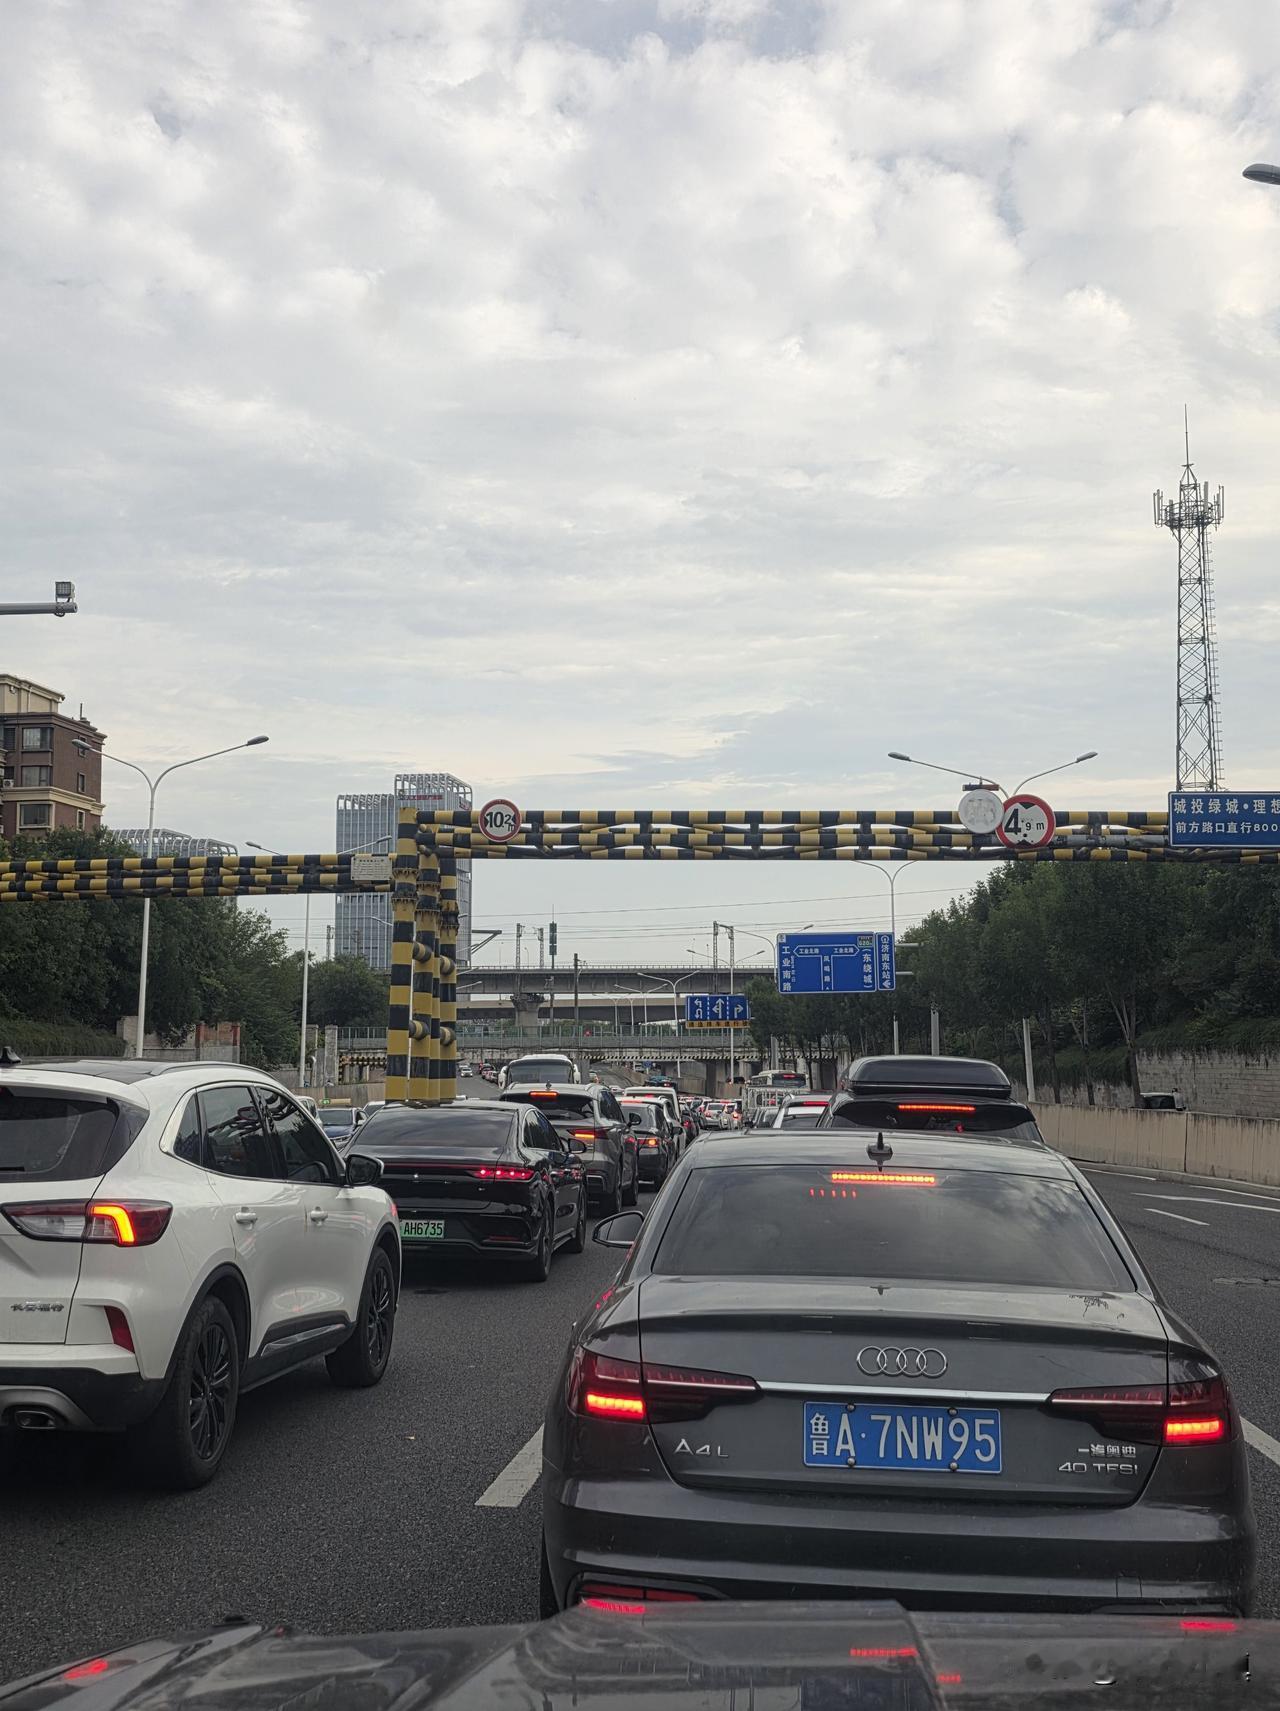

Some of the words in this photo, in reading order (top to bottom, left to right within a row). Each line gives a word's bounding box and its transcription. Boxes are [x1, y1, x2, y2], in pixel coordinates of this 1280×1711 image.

[781, 946, 792, 992] 工业南路
[880, 944, 891, 979] 济南东站
[1078, 1443, 1137, 1459] 一汽奥迪
[1058, 1461, 1087, 1473] 40
[1092, 1462, 1138, 1475] TFSI
